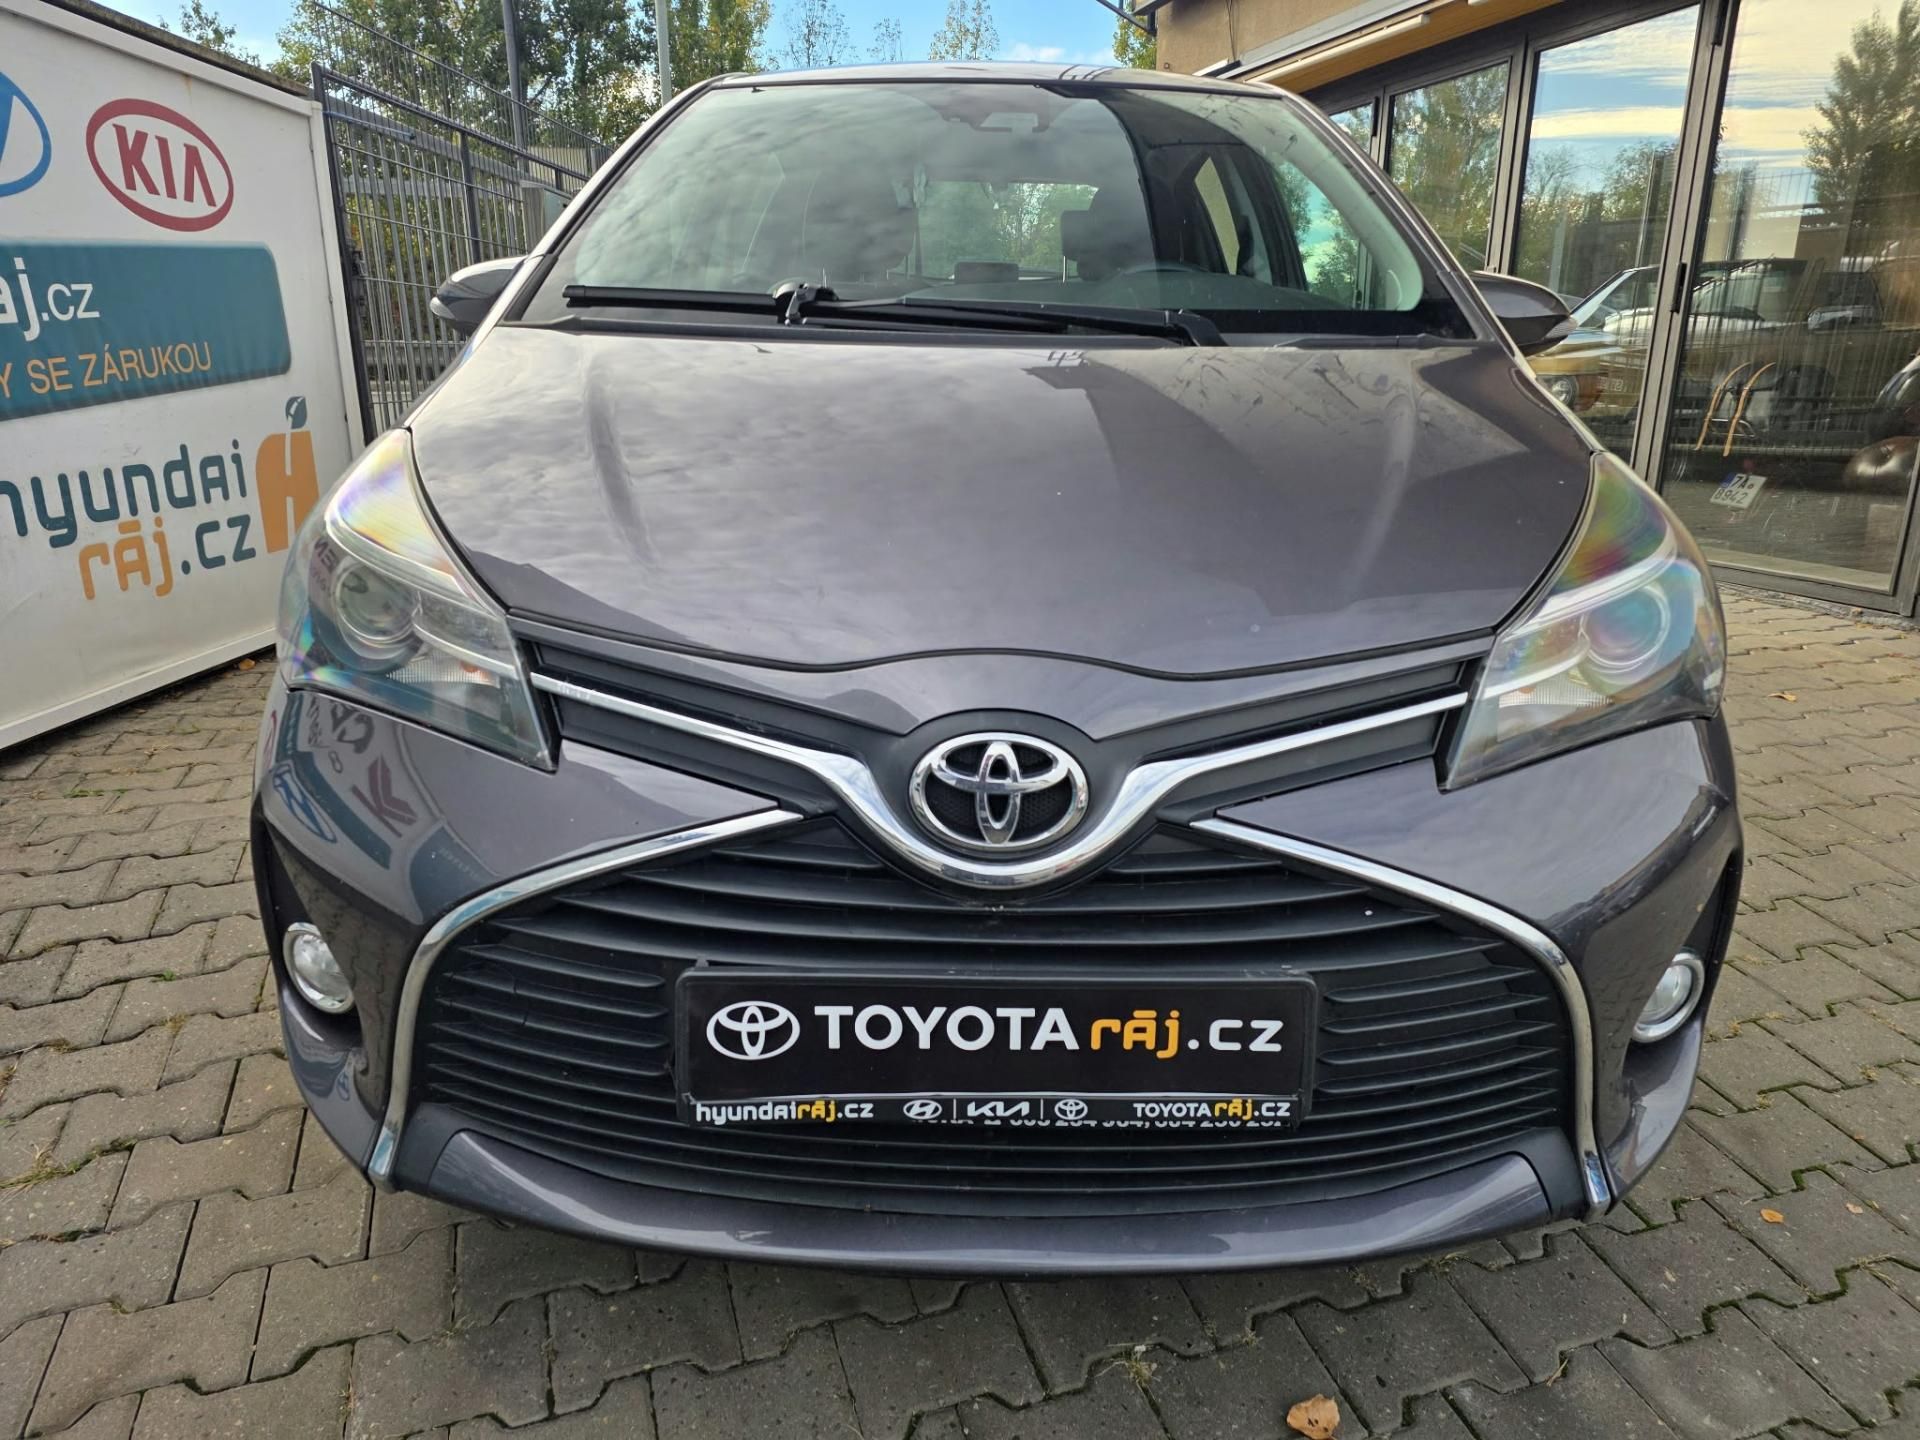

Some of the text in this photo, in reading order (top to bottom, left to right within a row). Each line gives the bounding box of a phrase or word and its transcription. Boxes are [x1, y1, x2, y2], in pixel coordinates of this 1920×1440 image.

[112, 123, 217, 207] KIA
[26, 356, 73, 394] SE
[78, 341, 212, 386] ZÁRUKOU
[814, 1004, 1080, 1051] TOYOTA
